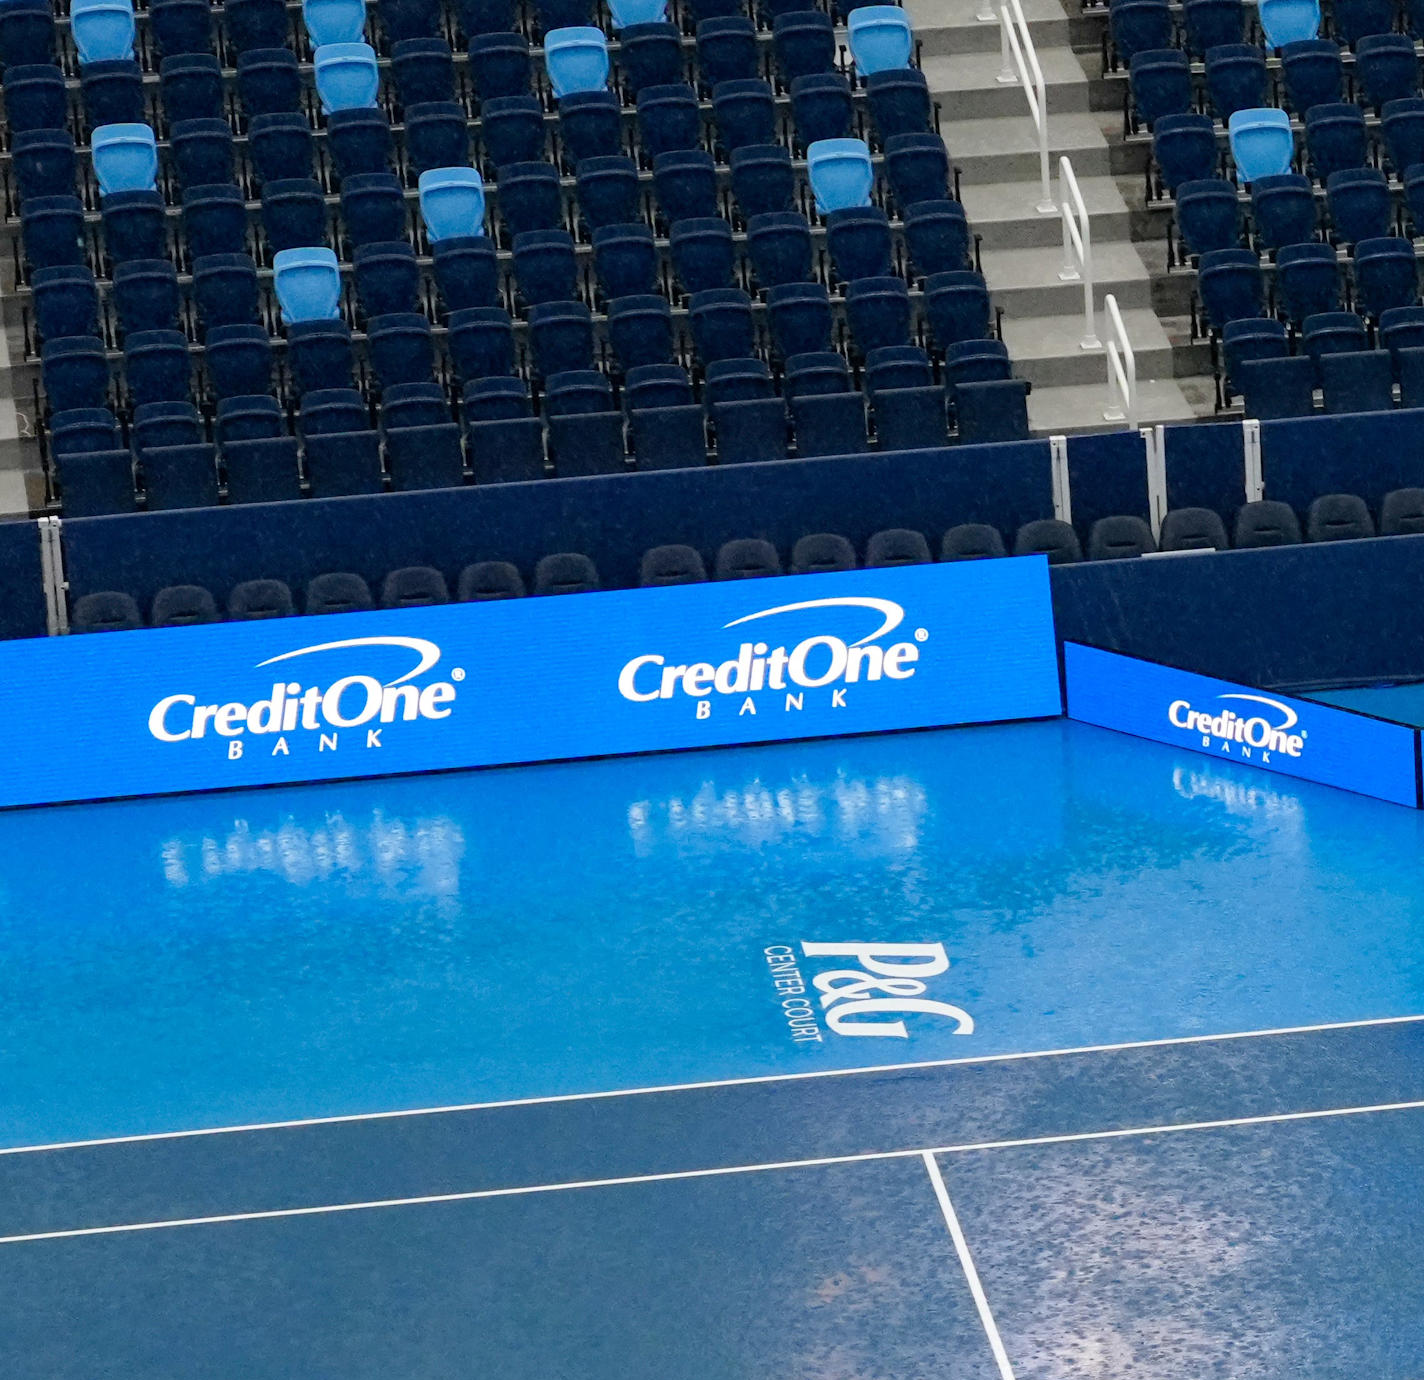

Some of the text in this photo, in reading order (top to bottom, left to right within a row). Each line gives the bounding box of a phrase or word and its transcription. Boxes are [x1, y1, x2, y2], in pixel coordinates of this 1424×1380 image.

[618, 635, 919, 704] CreditOne
[148, 674, 456, 743] CreditOne
[695, 687, 847, 720] BANK
[1168, 700, 1304, 757] CreditOne
[227, 728, 382, 760] BANK
[1201, 735, 1271, 765] BANK
[763, 945, 823, 1043] CENTER COURT
[801, 941, 975, 1039] P&G
